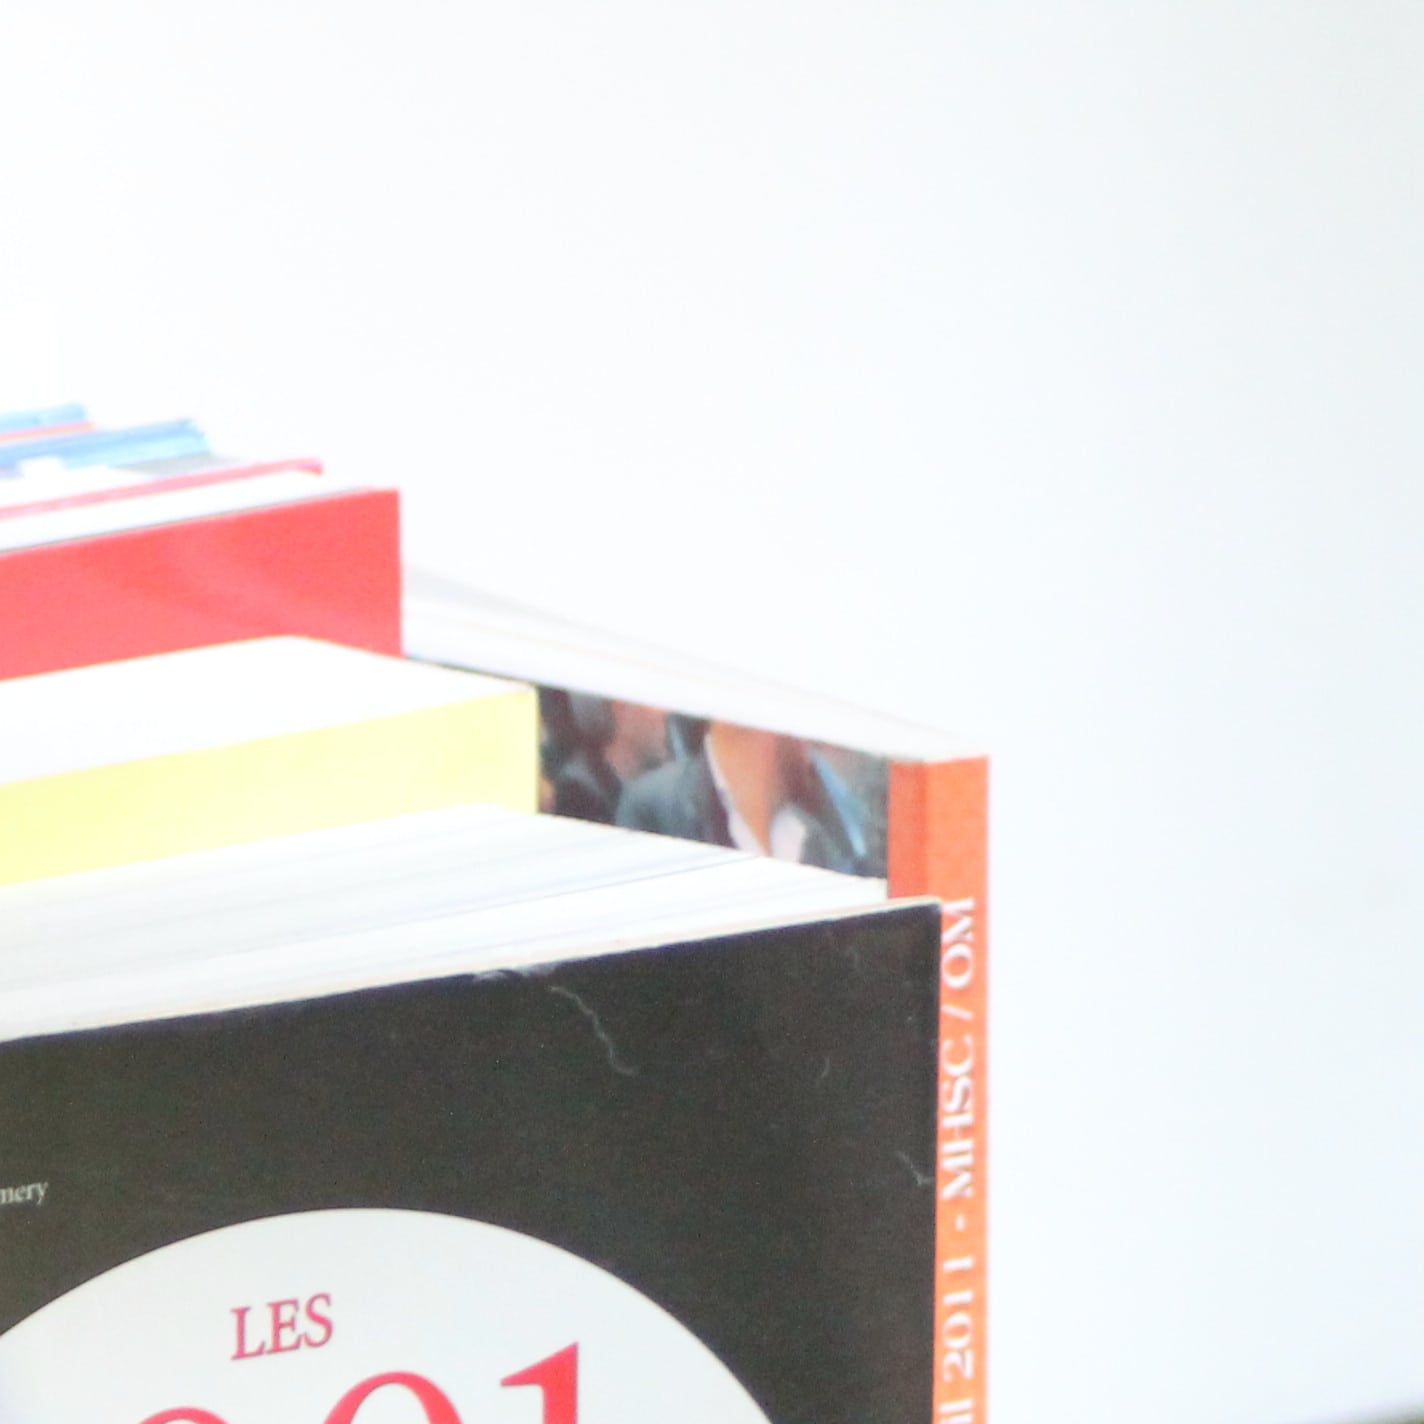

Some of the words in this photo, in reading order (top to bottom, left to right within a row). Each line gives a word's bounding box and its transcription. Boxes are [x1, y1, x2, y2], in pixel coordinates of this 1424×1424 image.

[941, 895, 975, 990] OM
[941, 1035, 975, 1199] MHSC
[230, 1293, 333, 1361] LES
[942, 1255, 974, 1379] 2011
